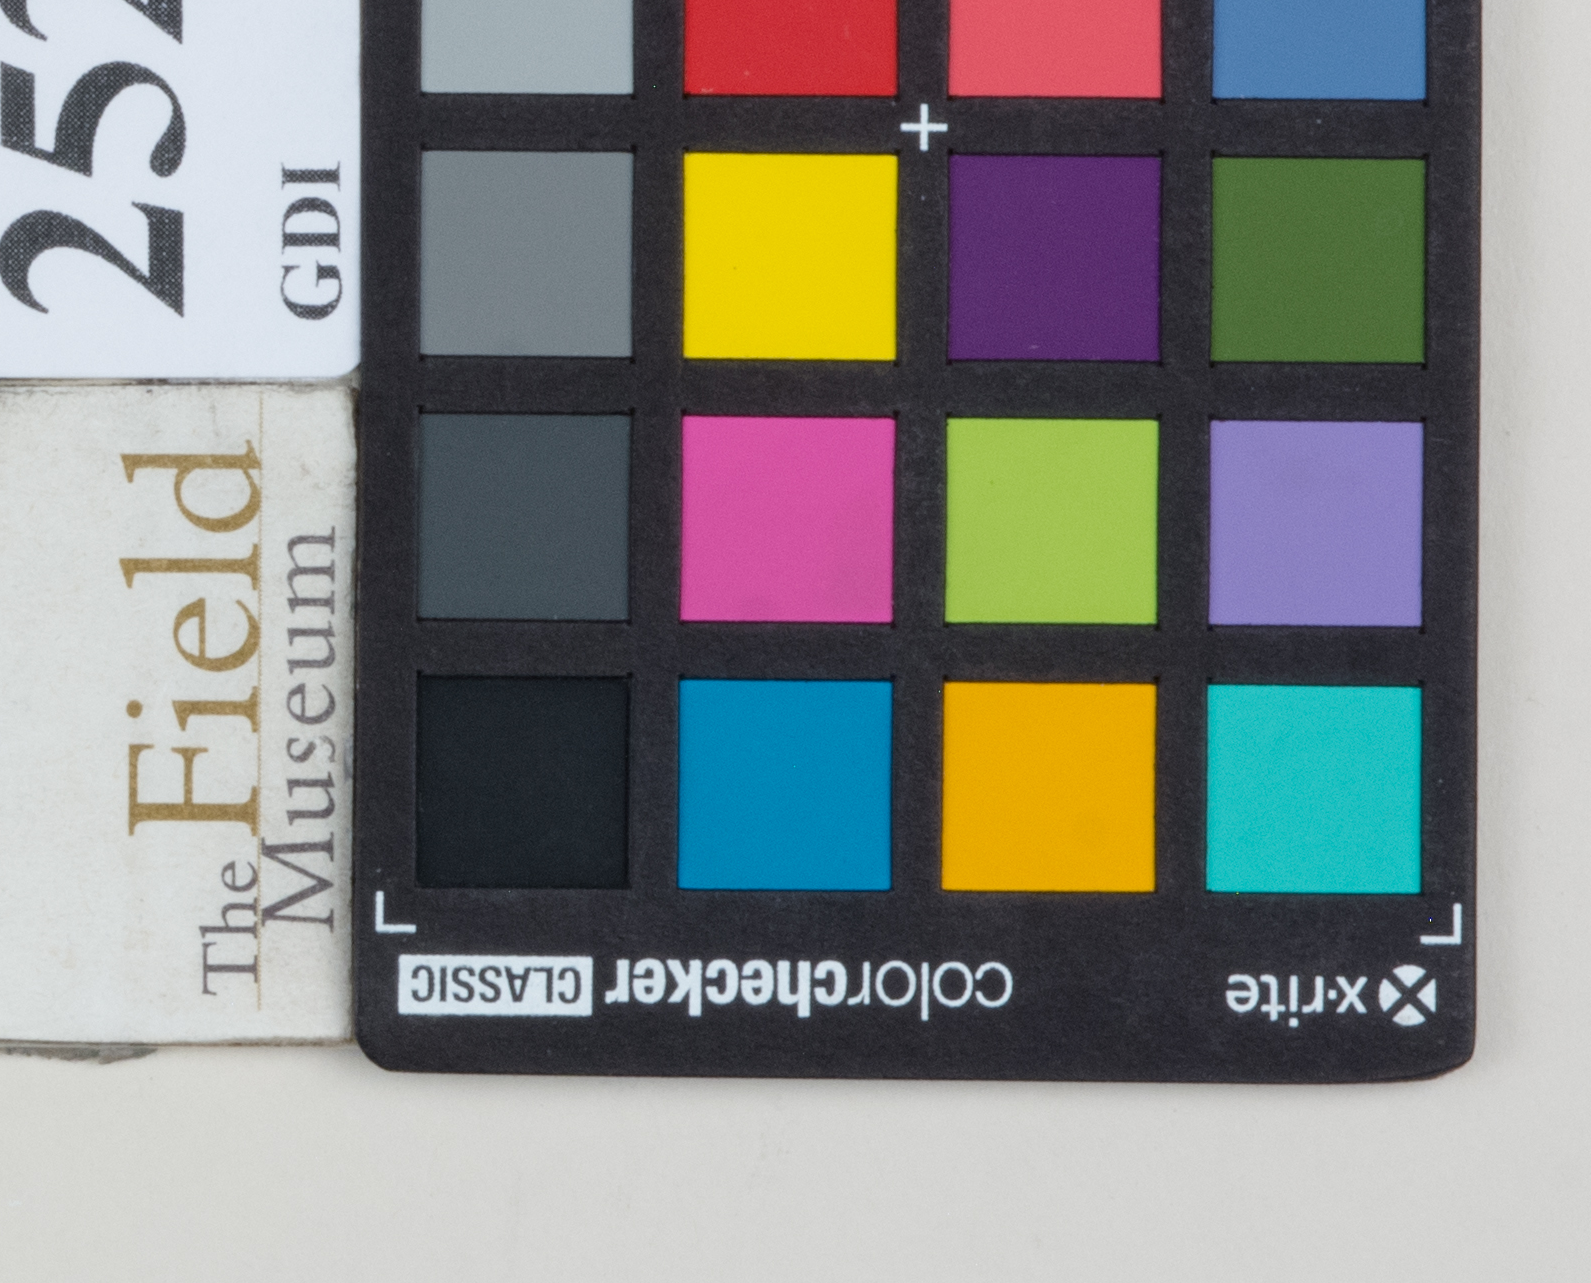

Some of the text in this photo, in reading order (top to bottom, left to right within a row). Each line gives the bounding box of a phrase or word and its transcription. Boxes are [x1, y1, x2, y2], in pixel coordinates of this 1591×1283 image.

[279, 162, 343, 322] GDI
[119, 438, 263, 997] The Field
[262, 524, 338, 934] Museum
[411, 957, 1015, 1023] colorchecker CLASSIC
